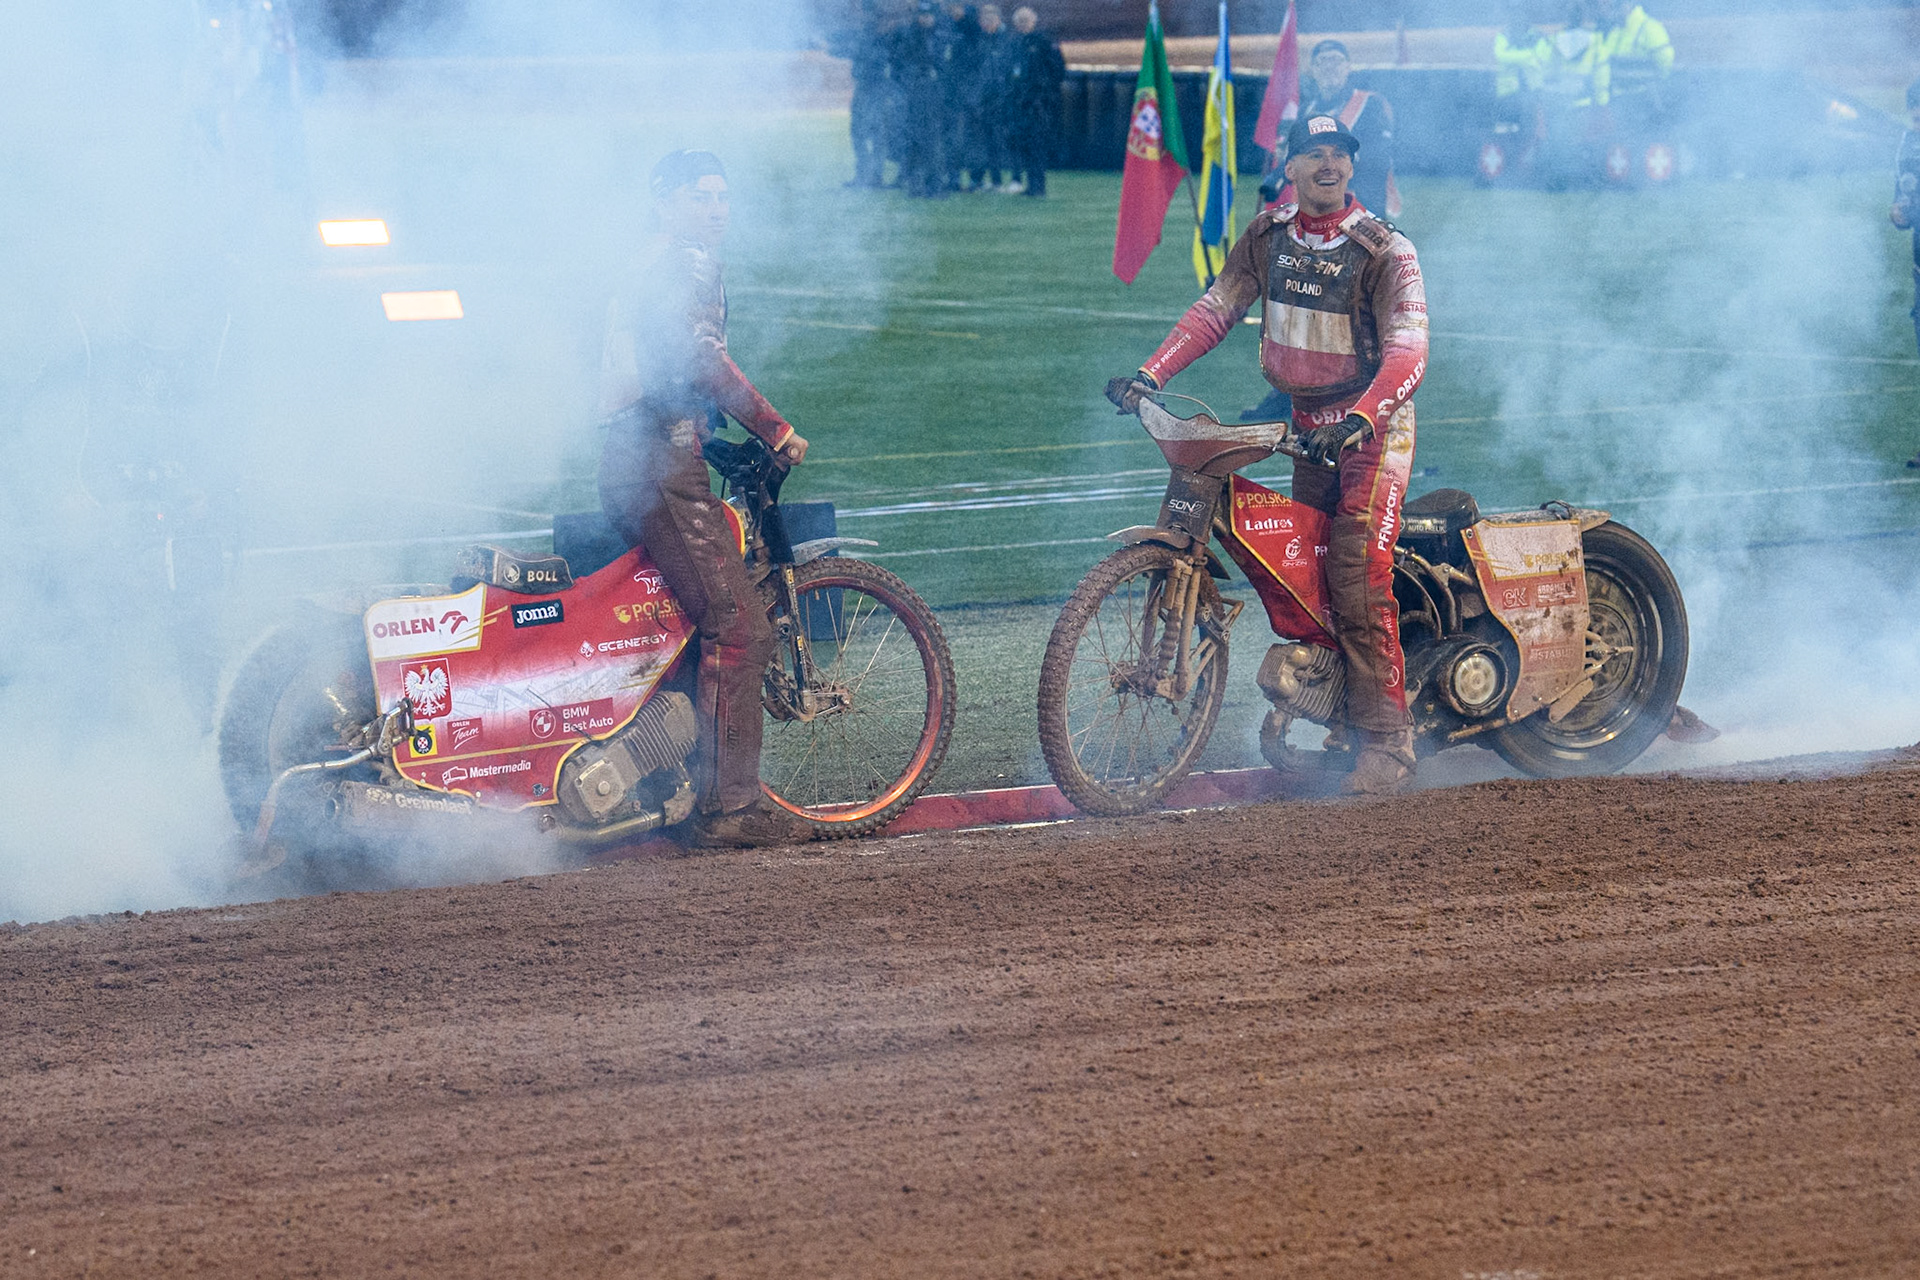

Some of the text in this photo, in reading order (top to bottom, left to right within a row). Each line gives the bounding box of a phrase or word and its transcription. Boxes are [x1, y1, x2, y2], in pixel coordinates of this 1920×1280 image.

[1314, 261, 1343, 277] FIM
[1285, 279, 1322, 296] POLAND
[1160, 333, 1192, 364] PRODUCTS
[1396, 356, 1426, 401] ORLEN
[527, 570, 558, 582] BOLL
[372, 617, 436, 639] ORLEN
[597, 632, 669, 653] GCENERGY
[562, 704, 590, 719] BMW
[562, 716, 614, 733] Best Auto
[452, 726, 480, 744] Team
[469, 759, 532, 778] Mastermedia
